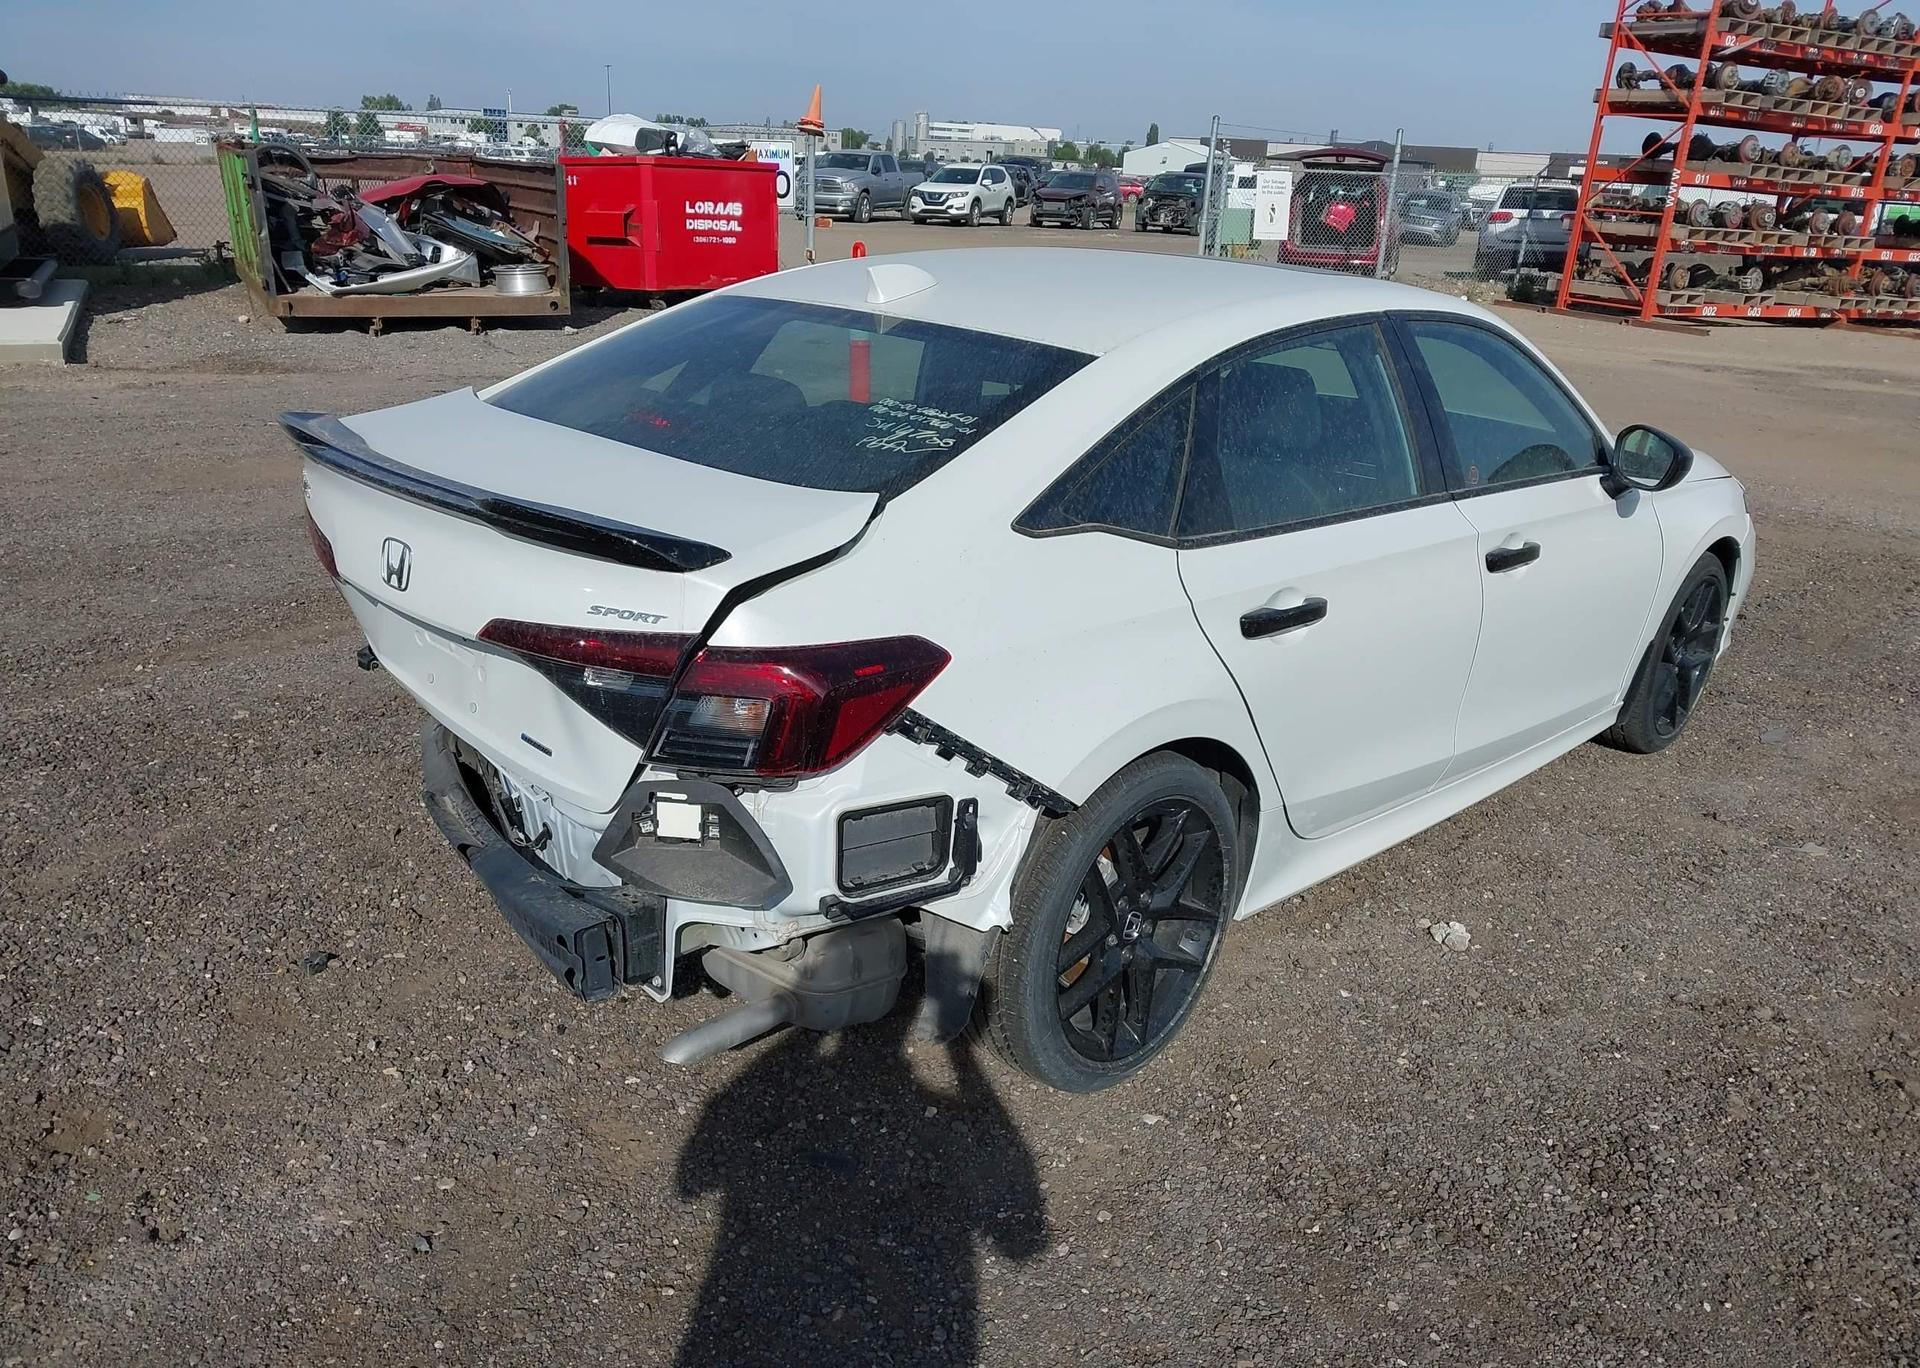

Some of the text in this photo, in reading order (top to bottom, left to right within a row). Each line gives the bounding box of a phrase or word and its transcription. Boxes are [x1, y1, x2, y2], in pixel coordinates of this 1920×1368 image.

[1725, 35, 1739, 46] 02
[1869, 124, 1883, 135] 020
[776, 170, 791, 199] 0
[1695, 173, 1710, 185] 011
[1851, 187, 1865, 197] 015
[685, 201, 743, 216] LORAAS
[686, 219, 743, 232] DISPOSAL
[1881, 250, 1894, 261] 031
[1702, 306, 1718, 316] 002
[1747, 307, 1762, 317] 003
[1788, 307, 1802, 317] 004
[586, 605, 669, 624] SPORT
